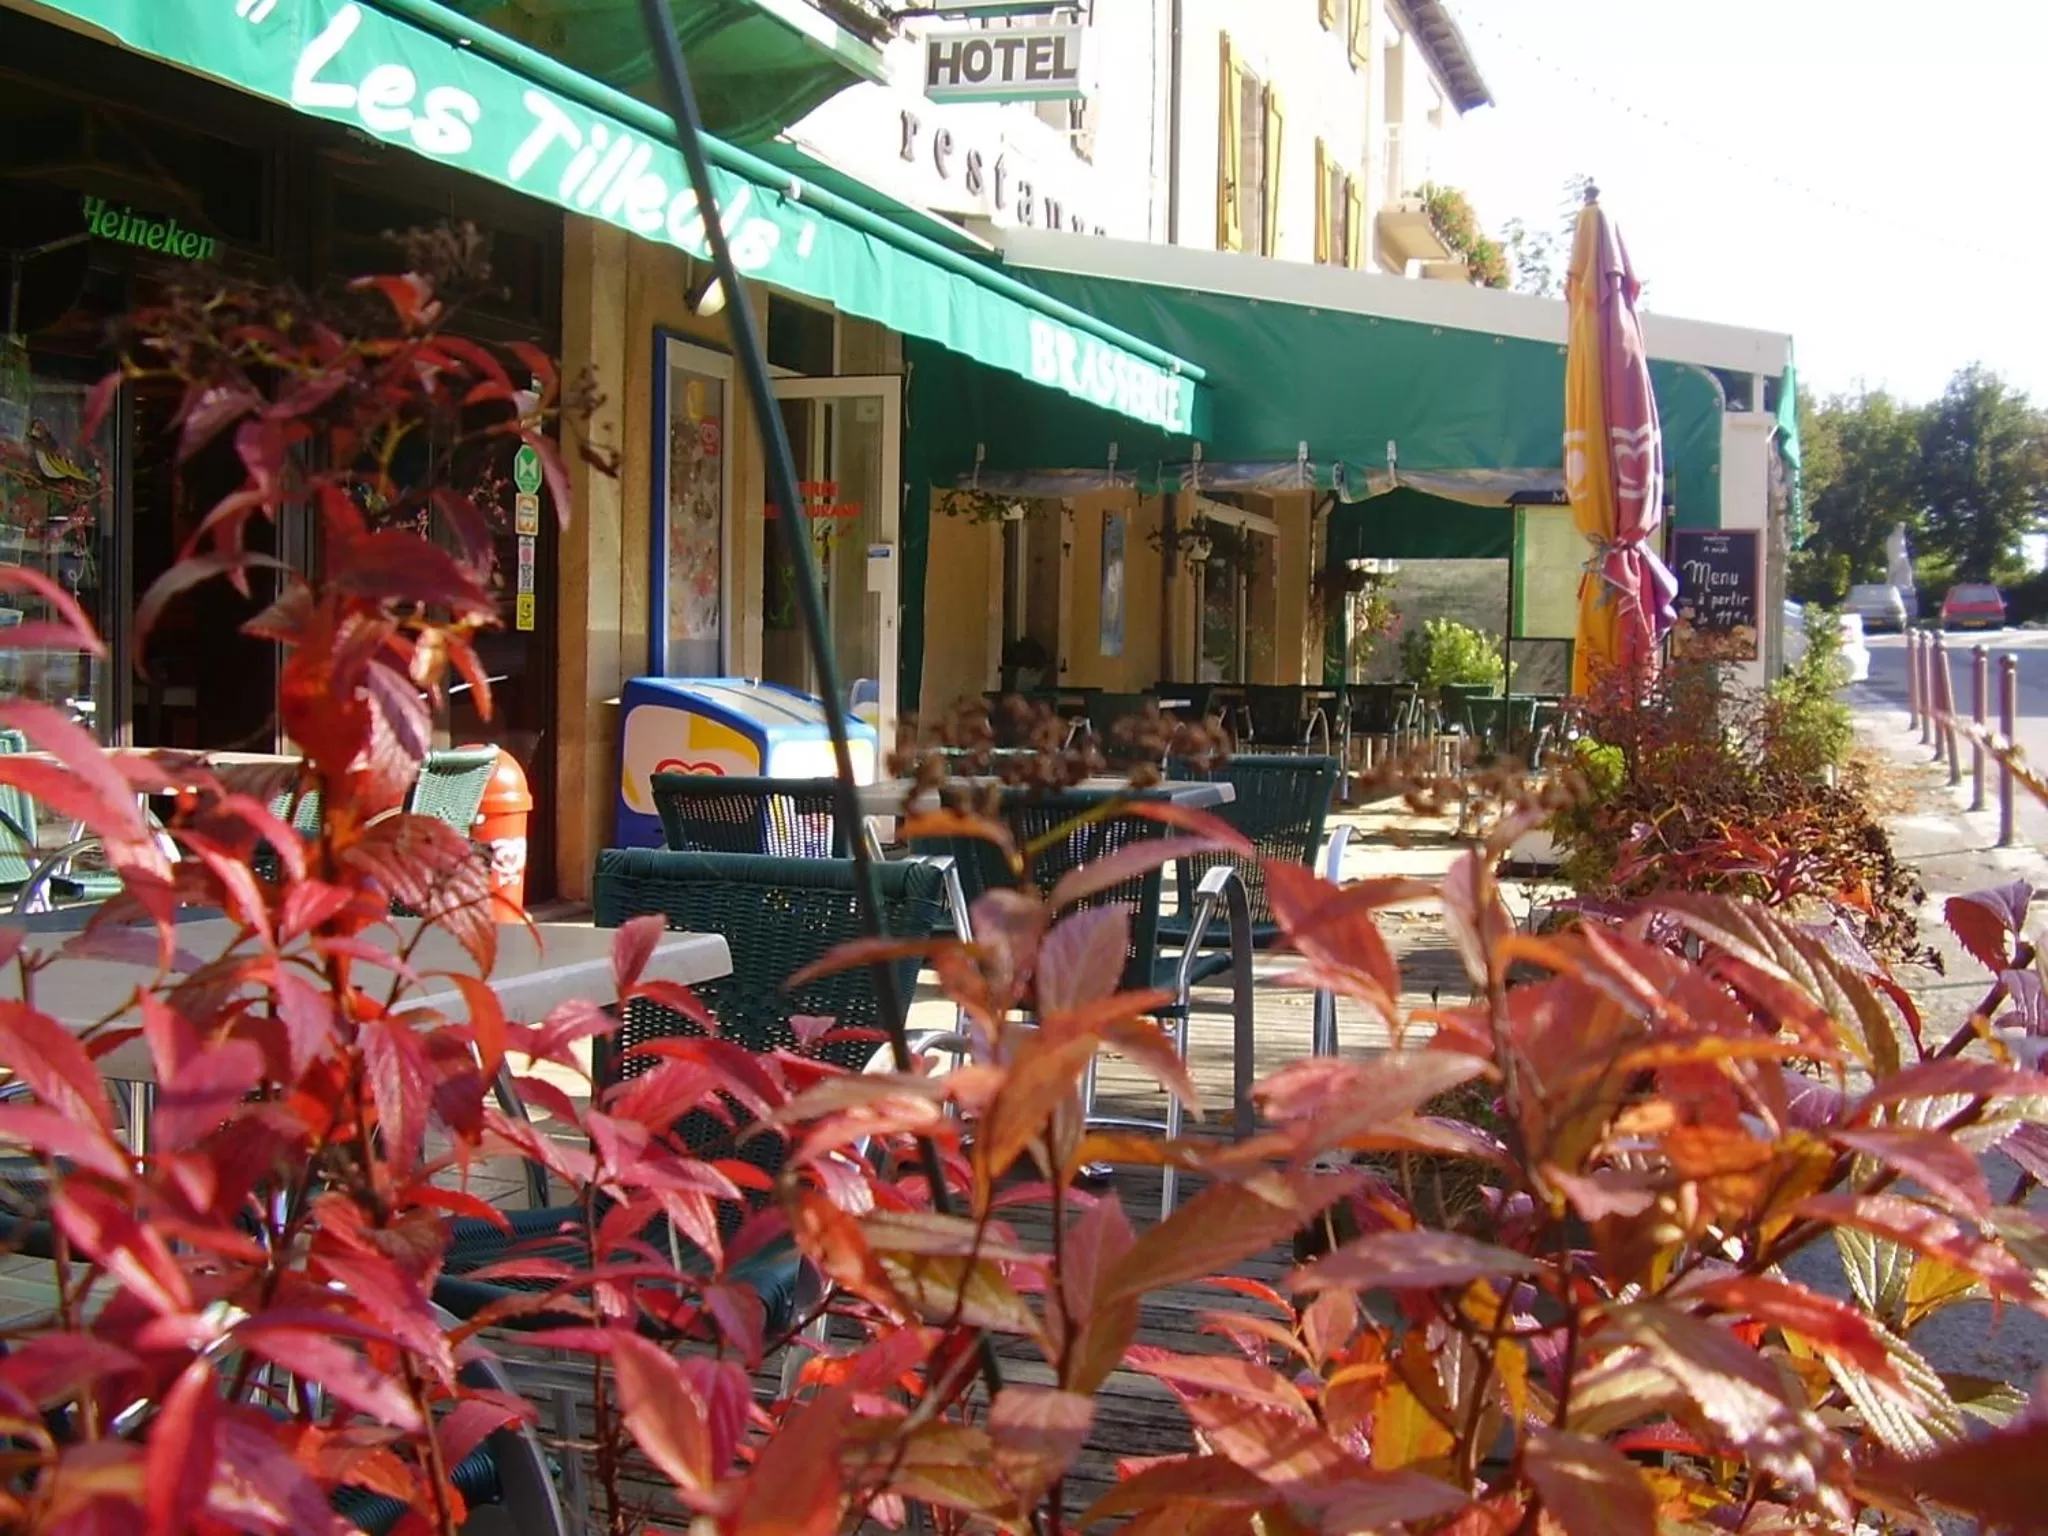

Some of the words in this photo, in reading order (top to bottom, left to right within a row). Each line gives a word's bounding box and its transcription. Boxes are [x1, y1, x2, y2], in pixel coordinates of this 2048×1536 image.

[291, 2, 480, 154] Les
[927, 36, 1077, 86] HOTEL
[83, 195, 216, 261] Heineken
[1029, 317, 1185, 433] BRASSERIE
[1683, 559, 1739, 592] Menu
